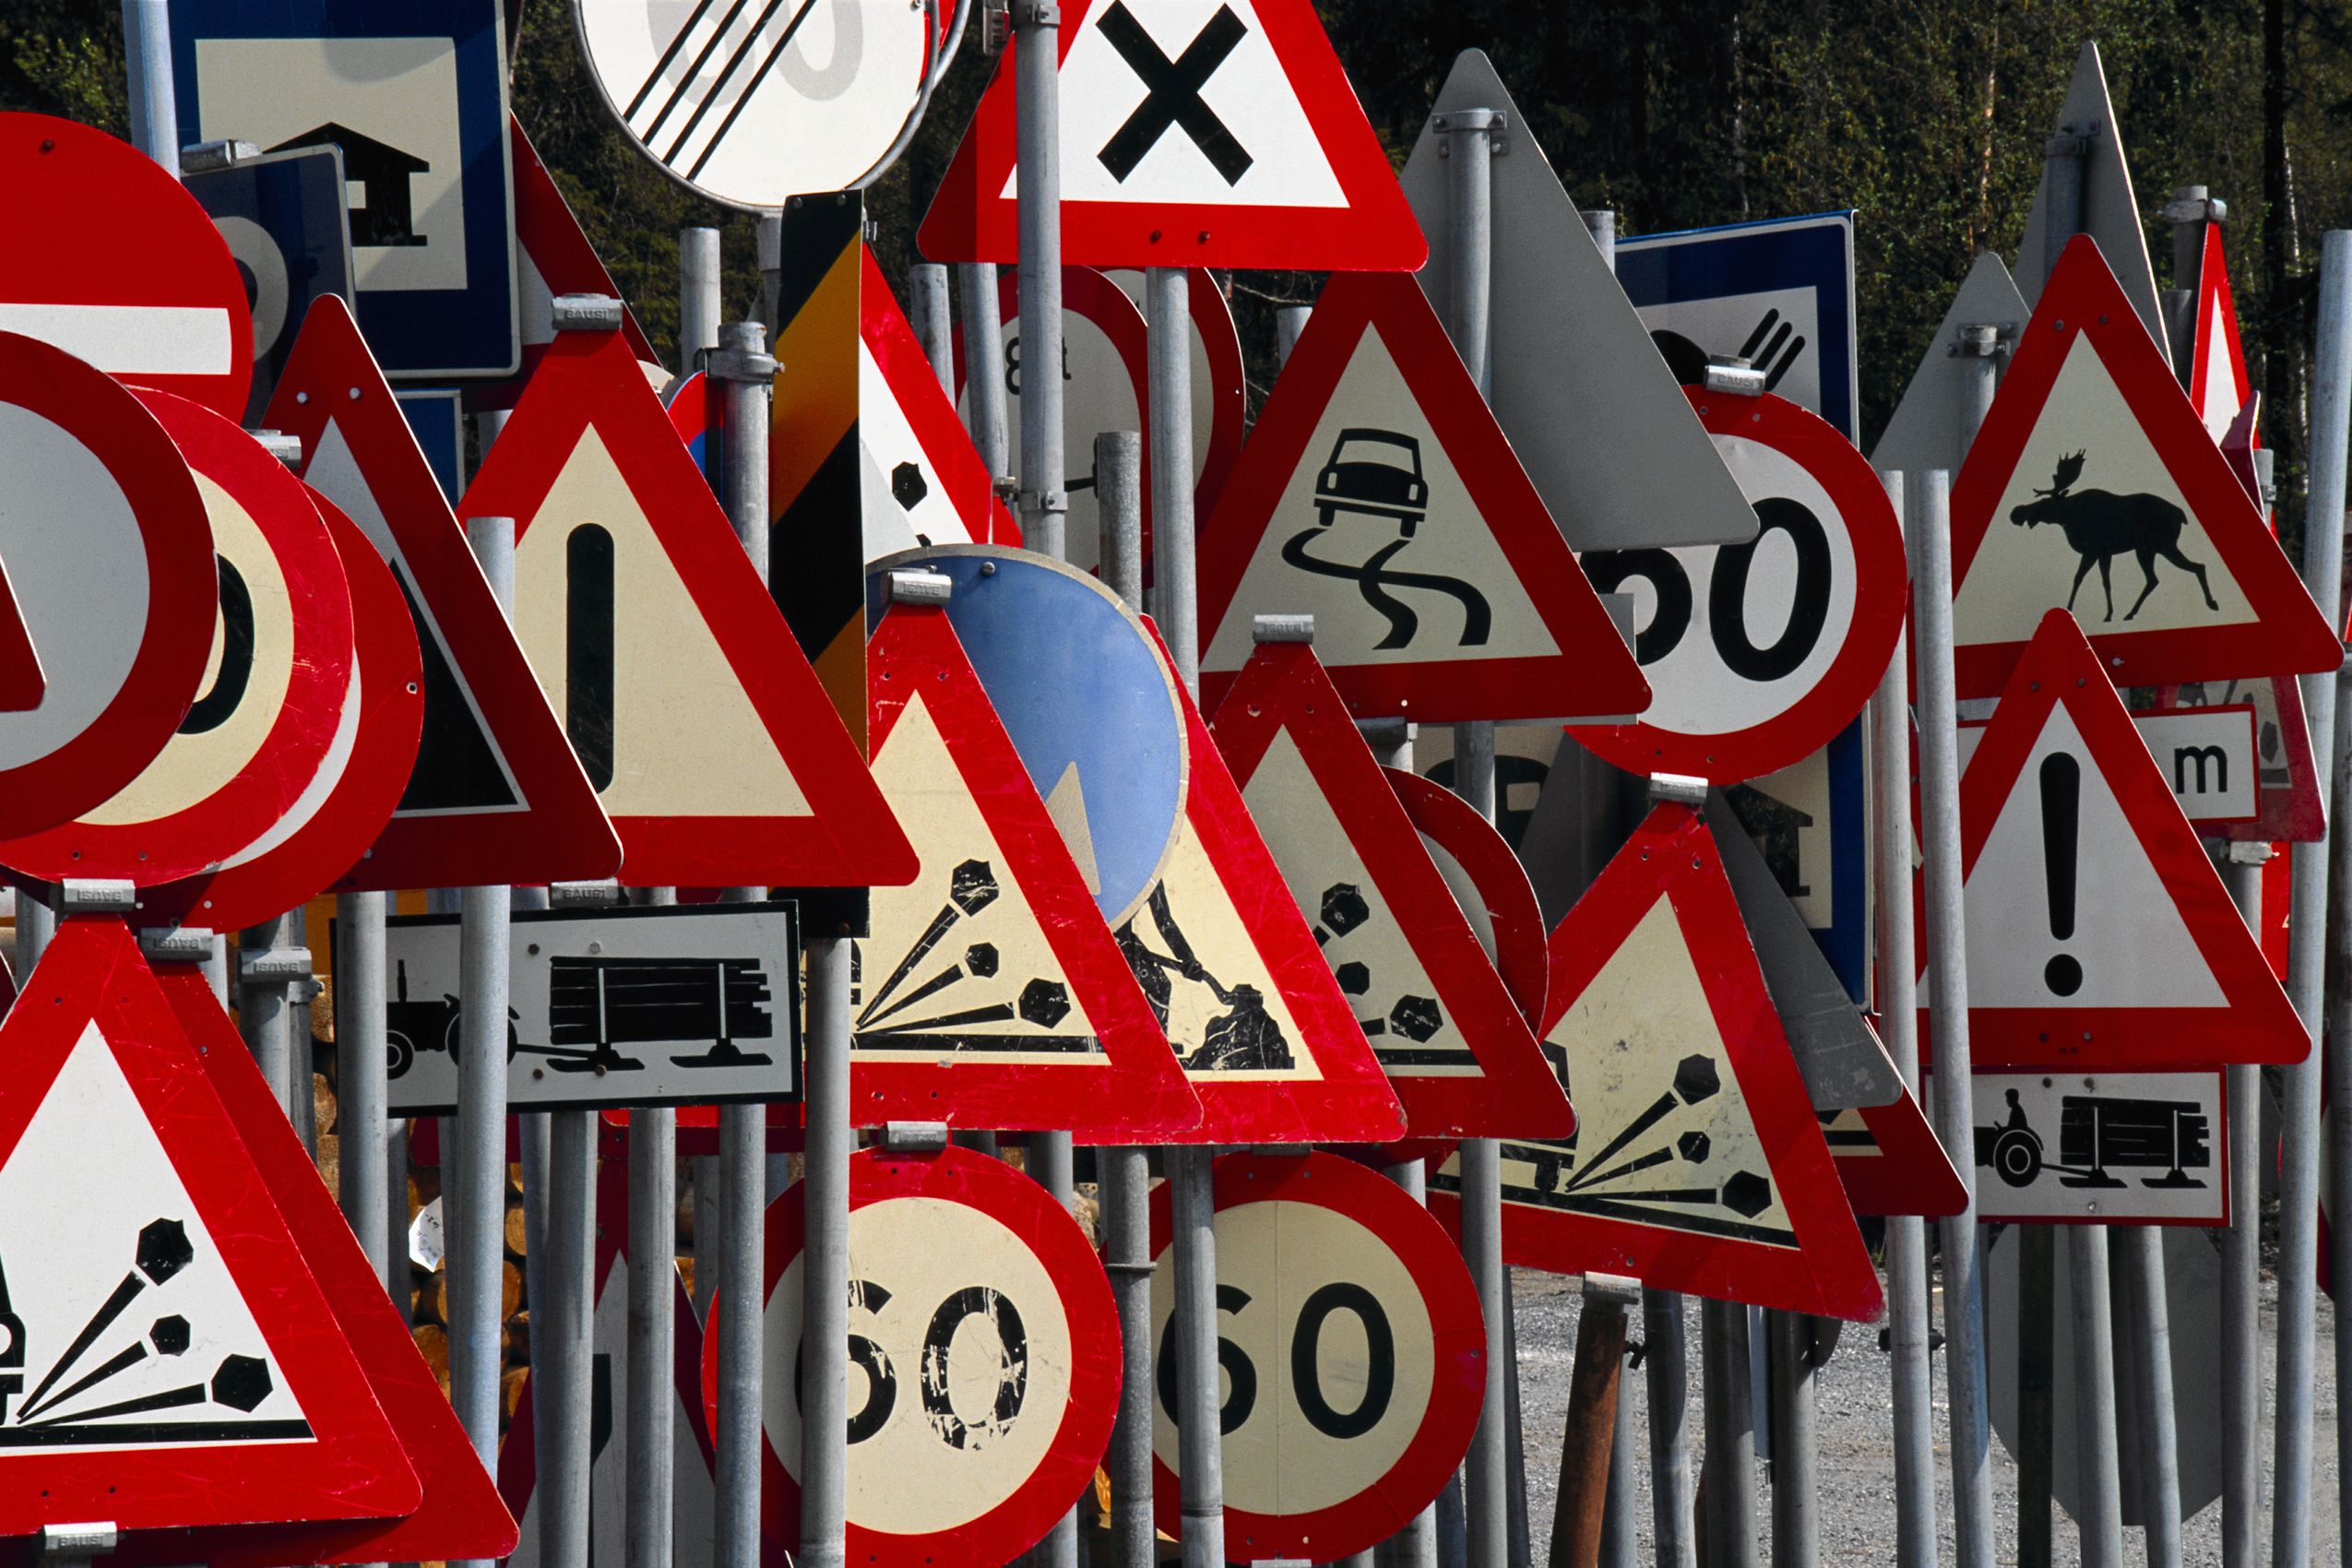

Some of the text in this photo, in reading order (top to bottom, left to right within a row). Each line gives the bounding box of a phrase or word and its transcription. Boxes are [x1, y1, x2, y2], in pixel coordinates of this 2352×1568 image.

[2174, 744, 2228, 794] m
[794, 1278, 1028, 1451] 60
[1157, 1281, 1396, 1440] 60
